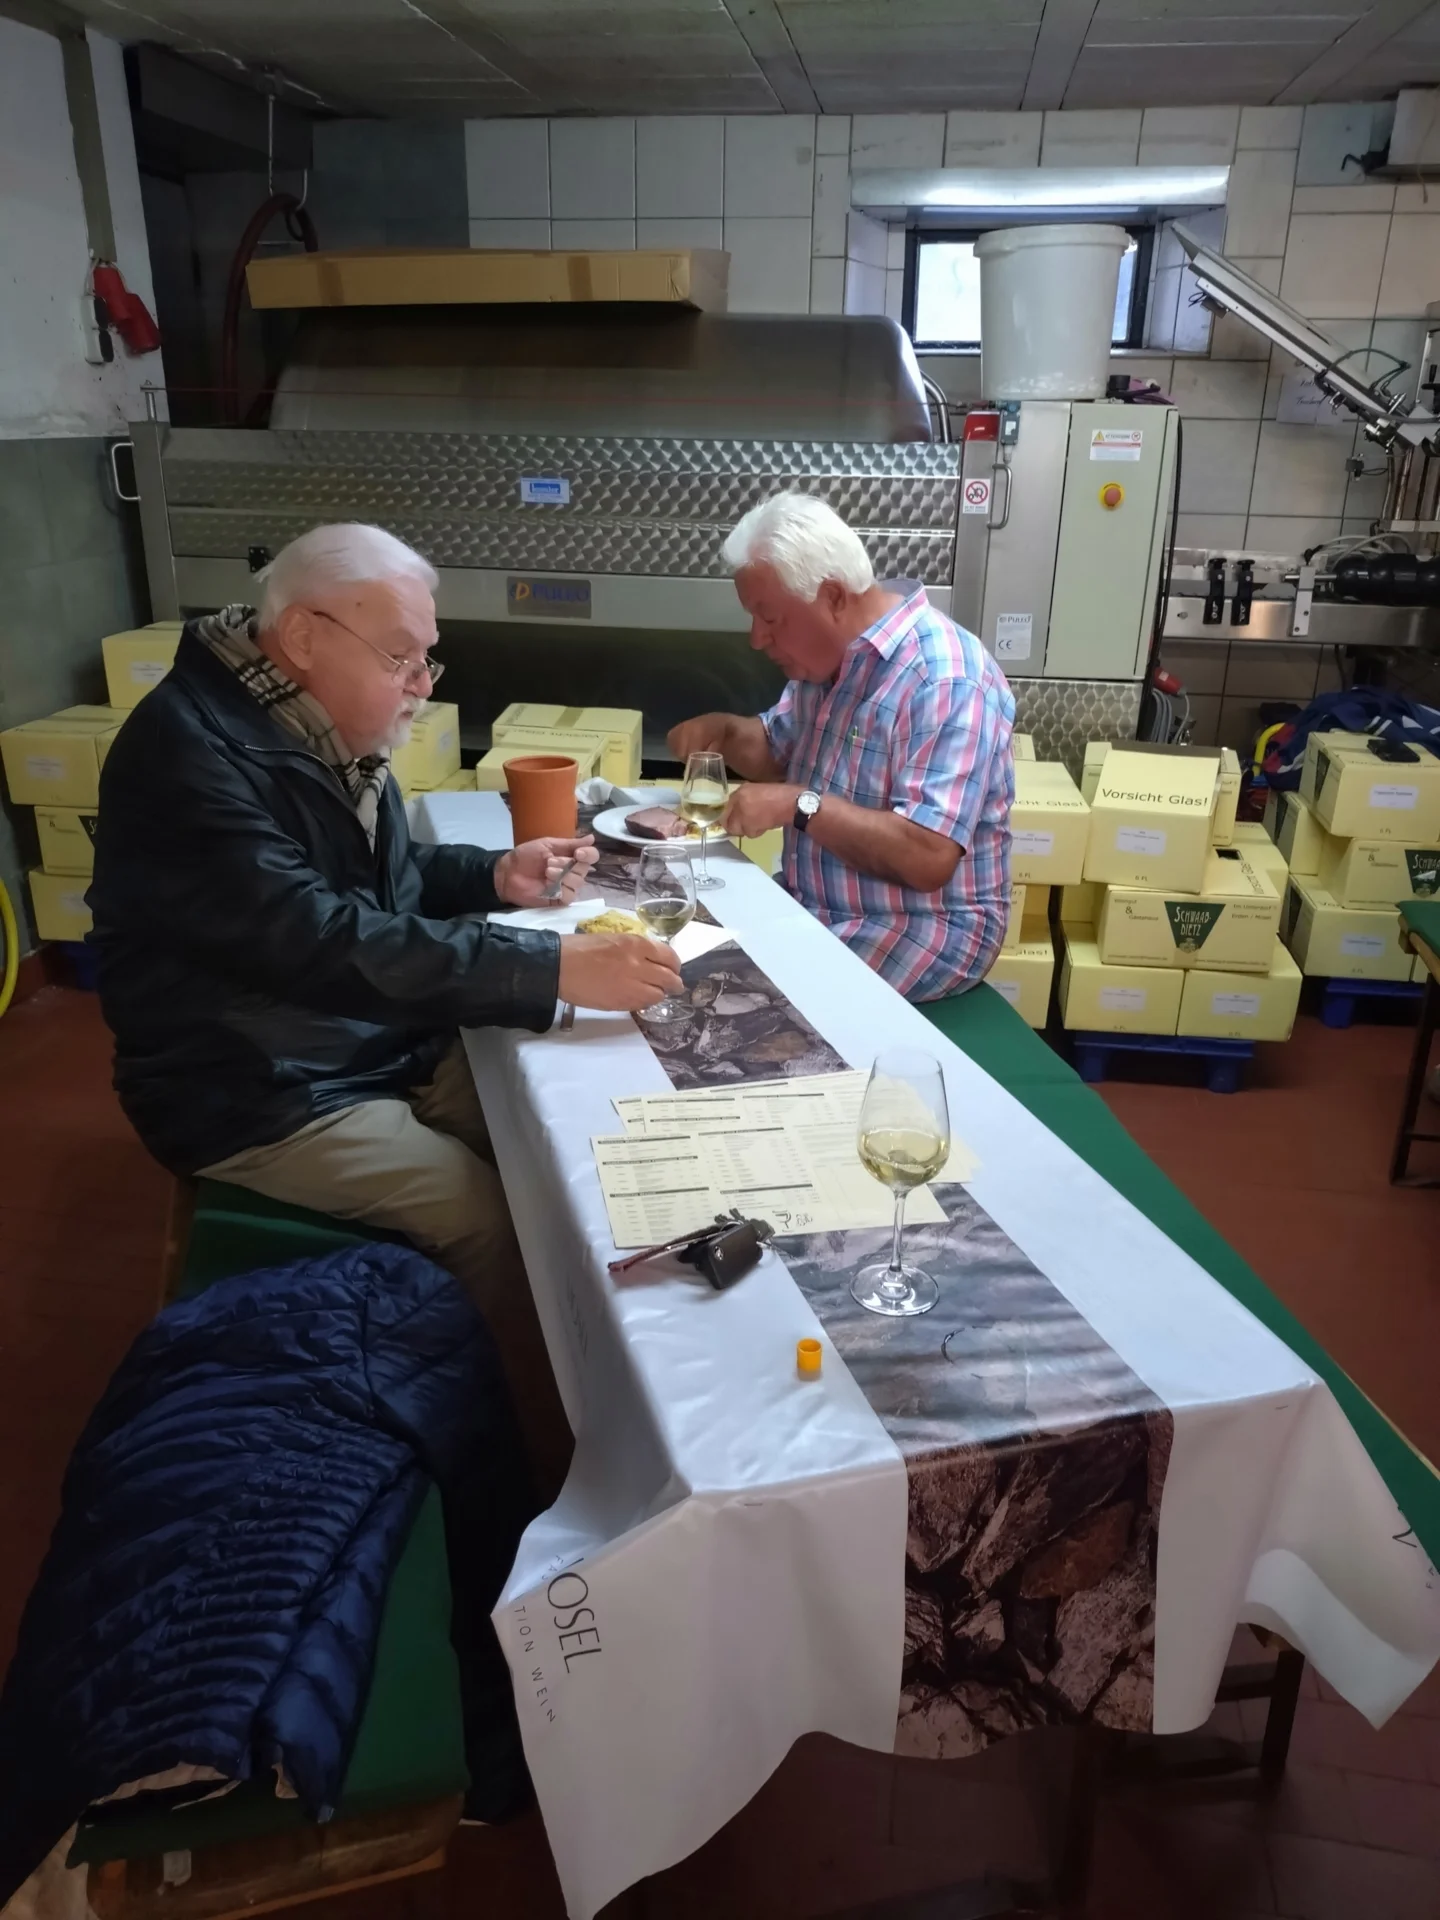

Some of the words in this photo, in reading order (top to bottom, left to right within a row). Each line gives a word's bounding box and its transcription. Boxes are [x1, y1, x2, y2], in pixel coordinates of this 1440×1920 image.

[1102, 788, 1163, 803] Vorsicht
[1168, 795, 1208, 807] Glas!
[1125, 906, 1133, 914] &
[1180, 923, 1202, 937] DIETZ
[531, 1666, 556, 1723] WEIN
